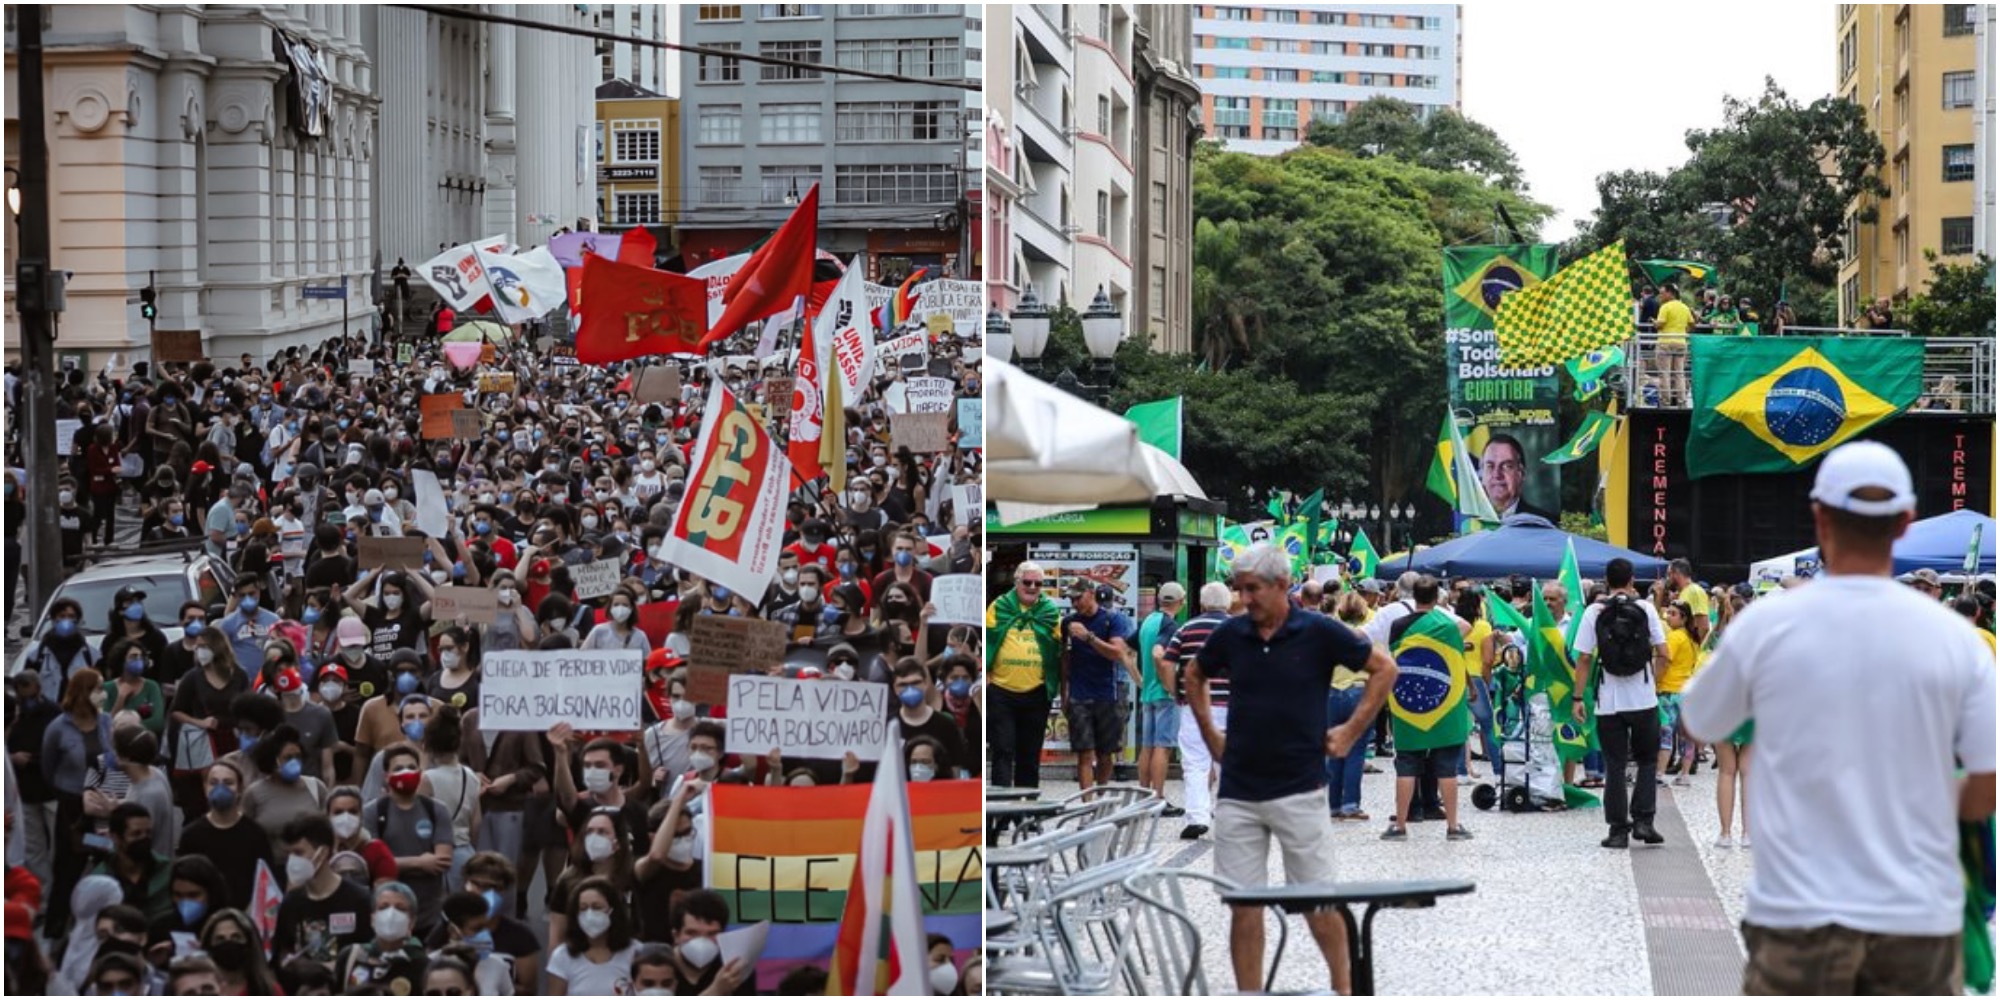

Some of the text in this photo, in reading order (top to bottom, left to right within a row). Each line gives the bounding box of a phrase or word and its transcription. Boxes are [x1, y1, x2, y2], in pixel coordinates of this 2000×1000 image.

[1465, 380, 1533, 401] CURITIBA
[1653, 428, 1667, 554] TREMENDA
[1034, 550, 1132, 561] SUPER PROMOÇÃO
[484, 658, 641, 678] CHEGA DE PERDER VIDAS
[483, 688, 640, 727] FORA BOLSONARO!
[733, 679, 806, 713] PELA
[814, 684, 884, 720] VIDA!
[731, 717, 883, 747] FORA BOLSONARO
[735, 853, 840, 924] ELE
